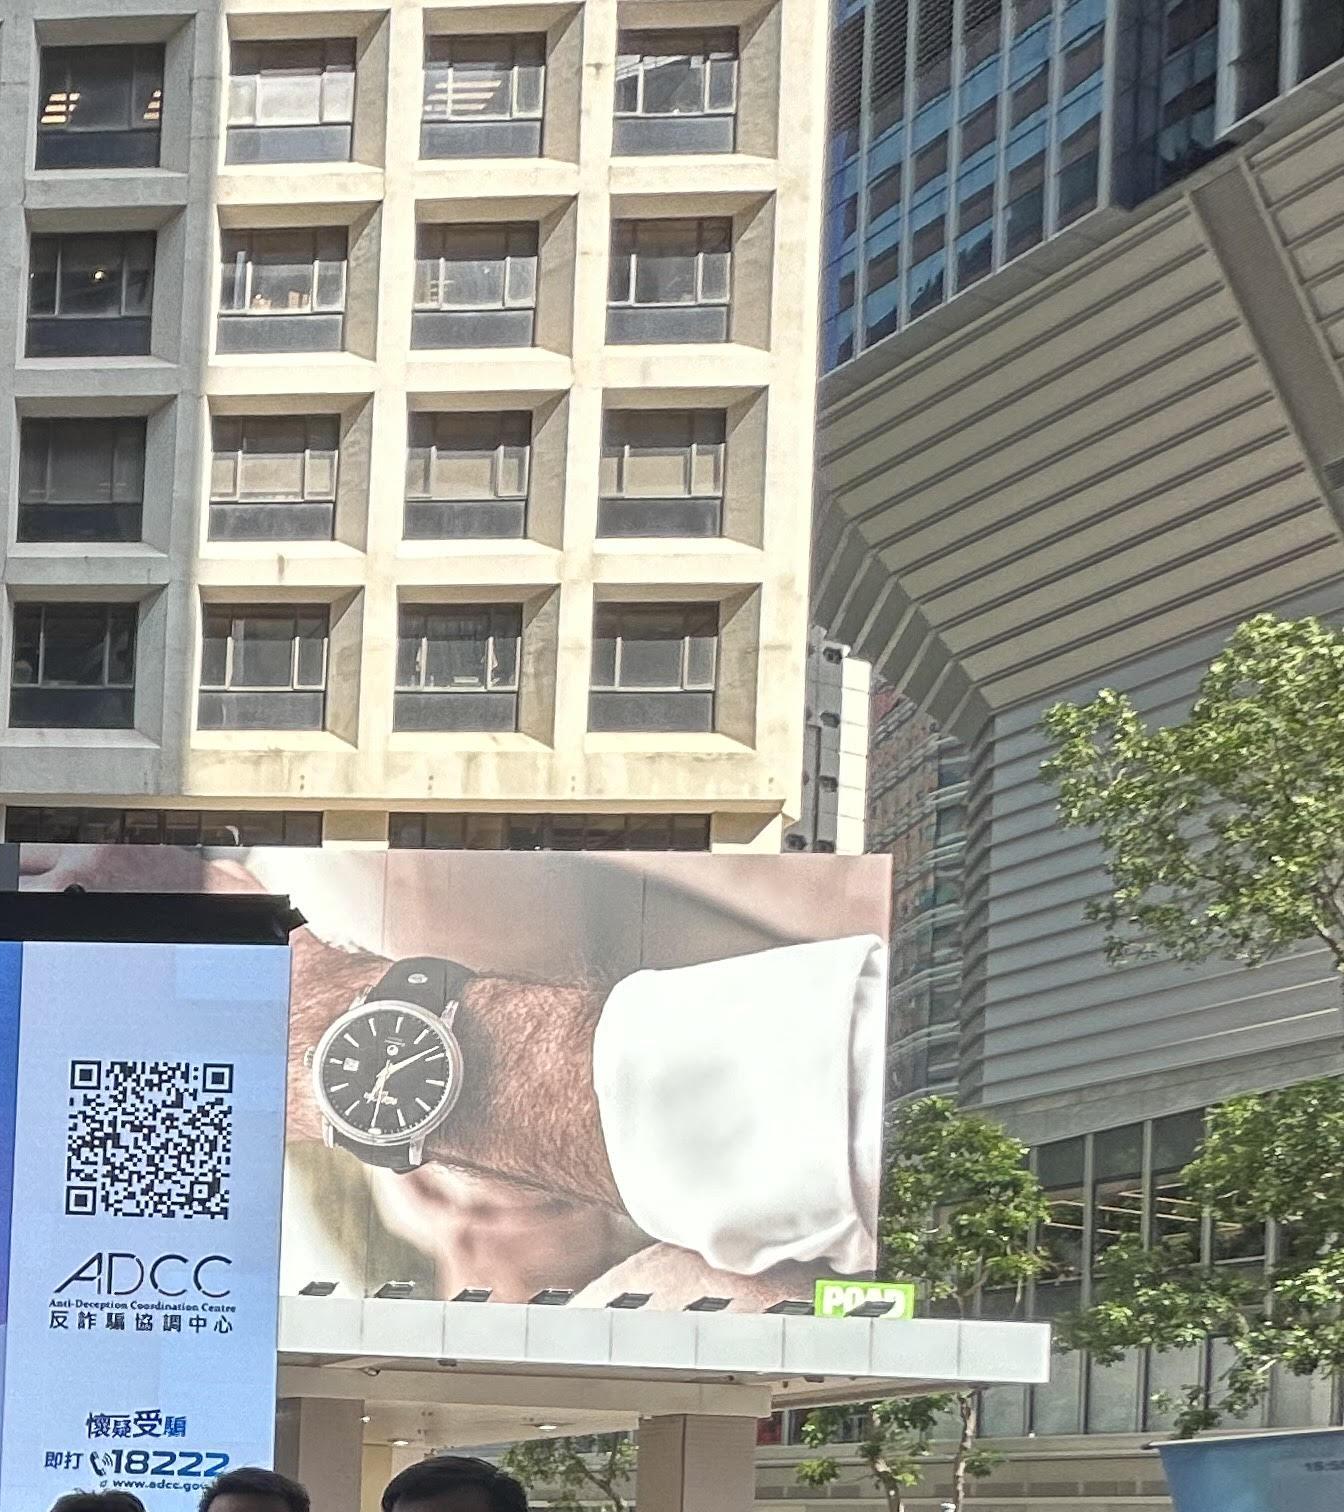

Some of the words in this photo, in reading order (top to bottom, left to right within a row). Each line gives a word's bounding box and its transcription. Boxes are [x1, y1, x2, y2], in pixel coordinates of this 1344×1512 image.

[53, 1252, 233, 1298] ADCC
[49, 1299, 128, 1311] Anti-Deception
[48, 1310, 233, 1334] 反詐騙協調中心
[45, 1451, 84, 1470] 即打
[111, 1449, 230, 1478] 18222
